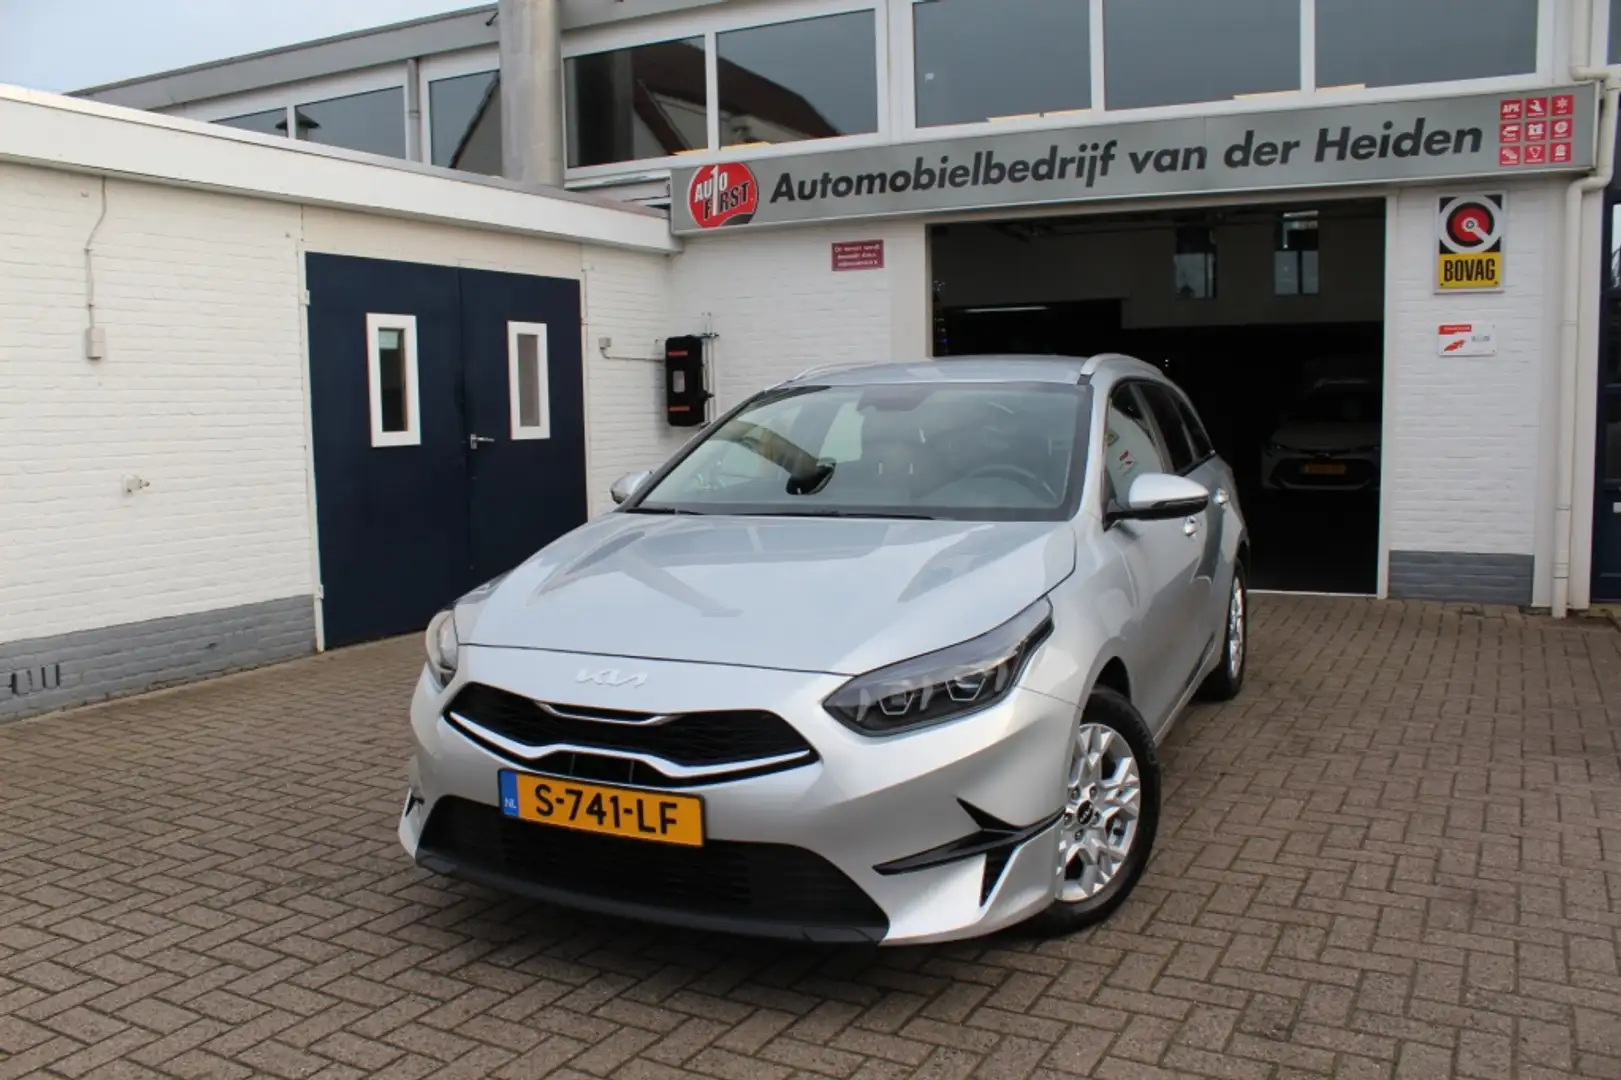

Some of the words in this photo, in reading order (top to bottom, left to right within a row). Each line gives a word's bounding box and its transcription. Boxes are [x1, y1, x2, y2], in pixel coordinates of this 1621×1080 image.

[769, 140, 1117, 203] Automobielbedrijf
[1128, 147, 1207, 174] van
[1223, 130, 1300, 169] der
[1314, 117, 1483, 162] Heiden
[1443, 259, 1496, 282] BOVAG
[503, 797, 517, 810] NL
[534, 783, 678, 835] S-741-LF
